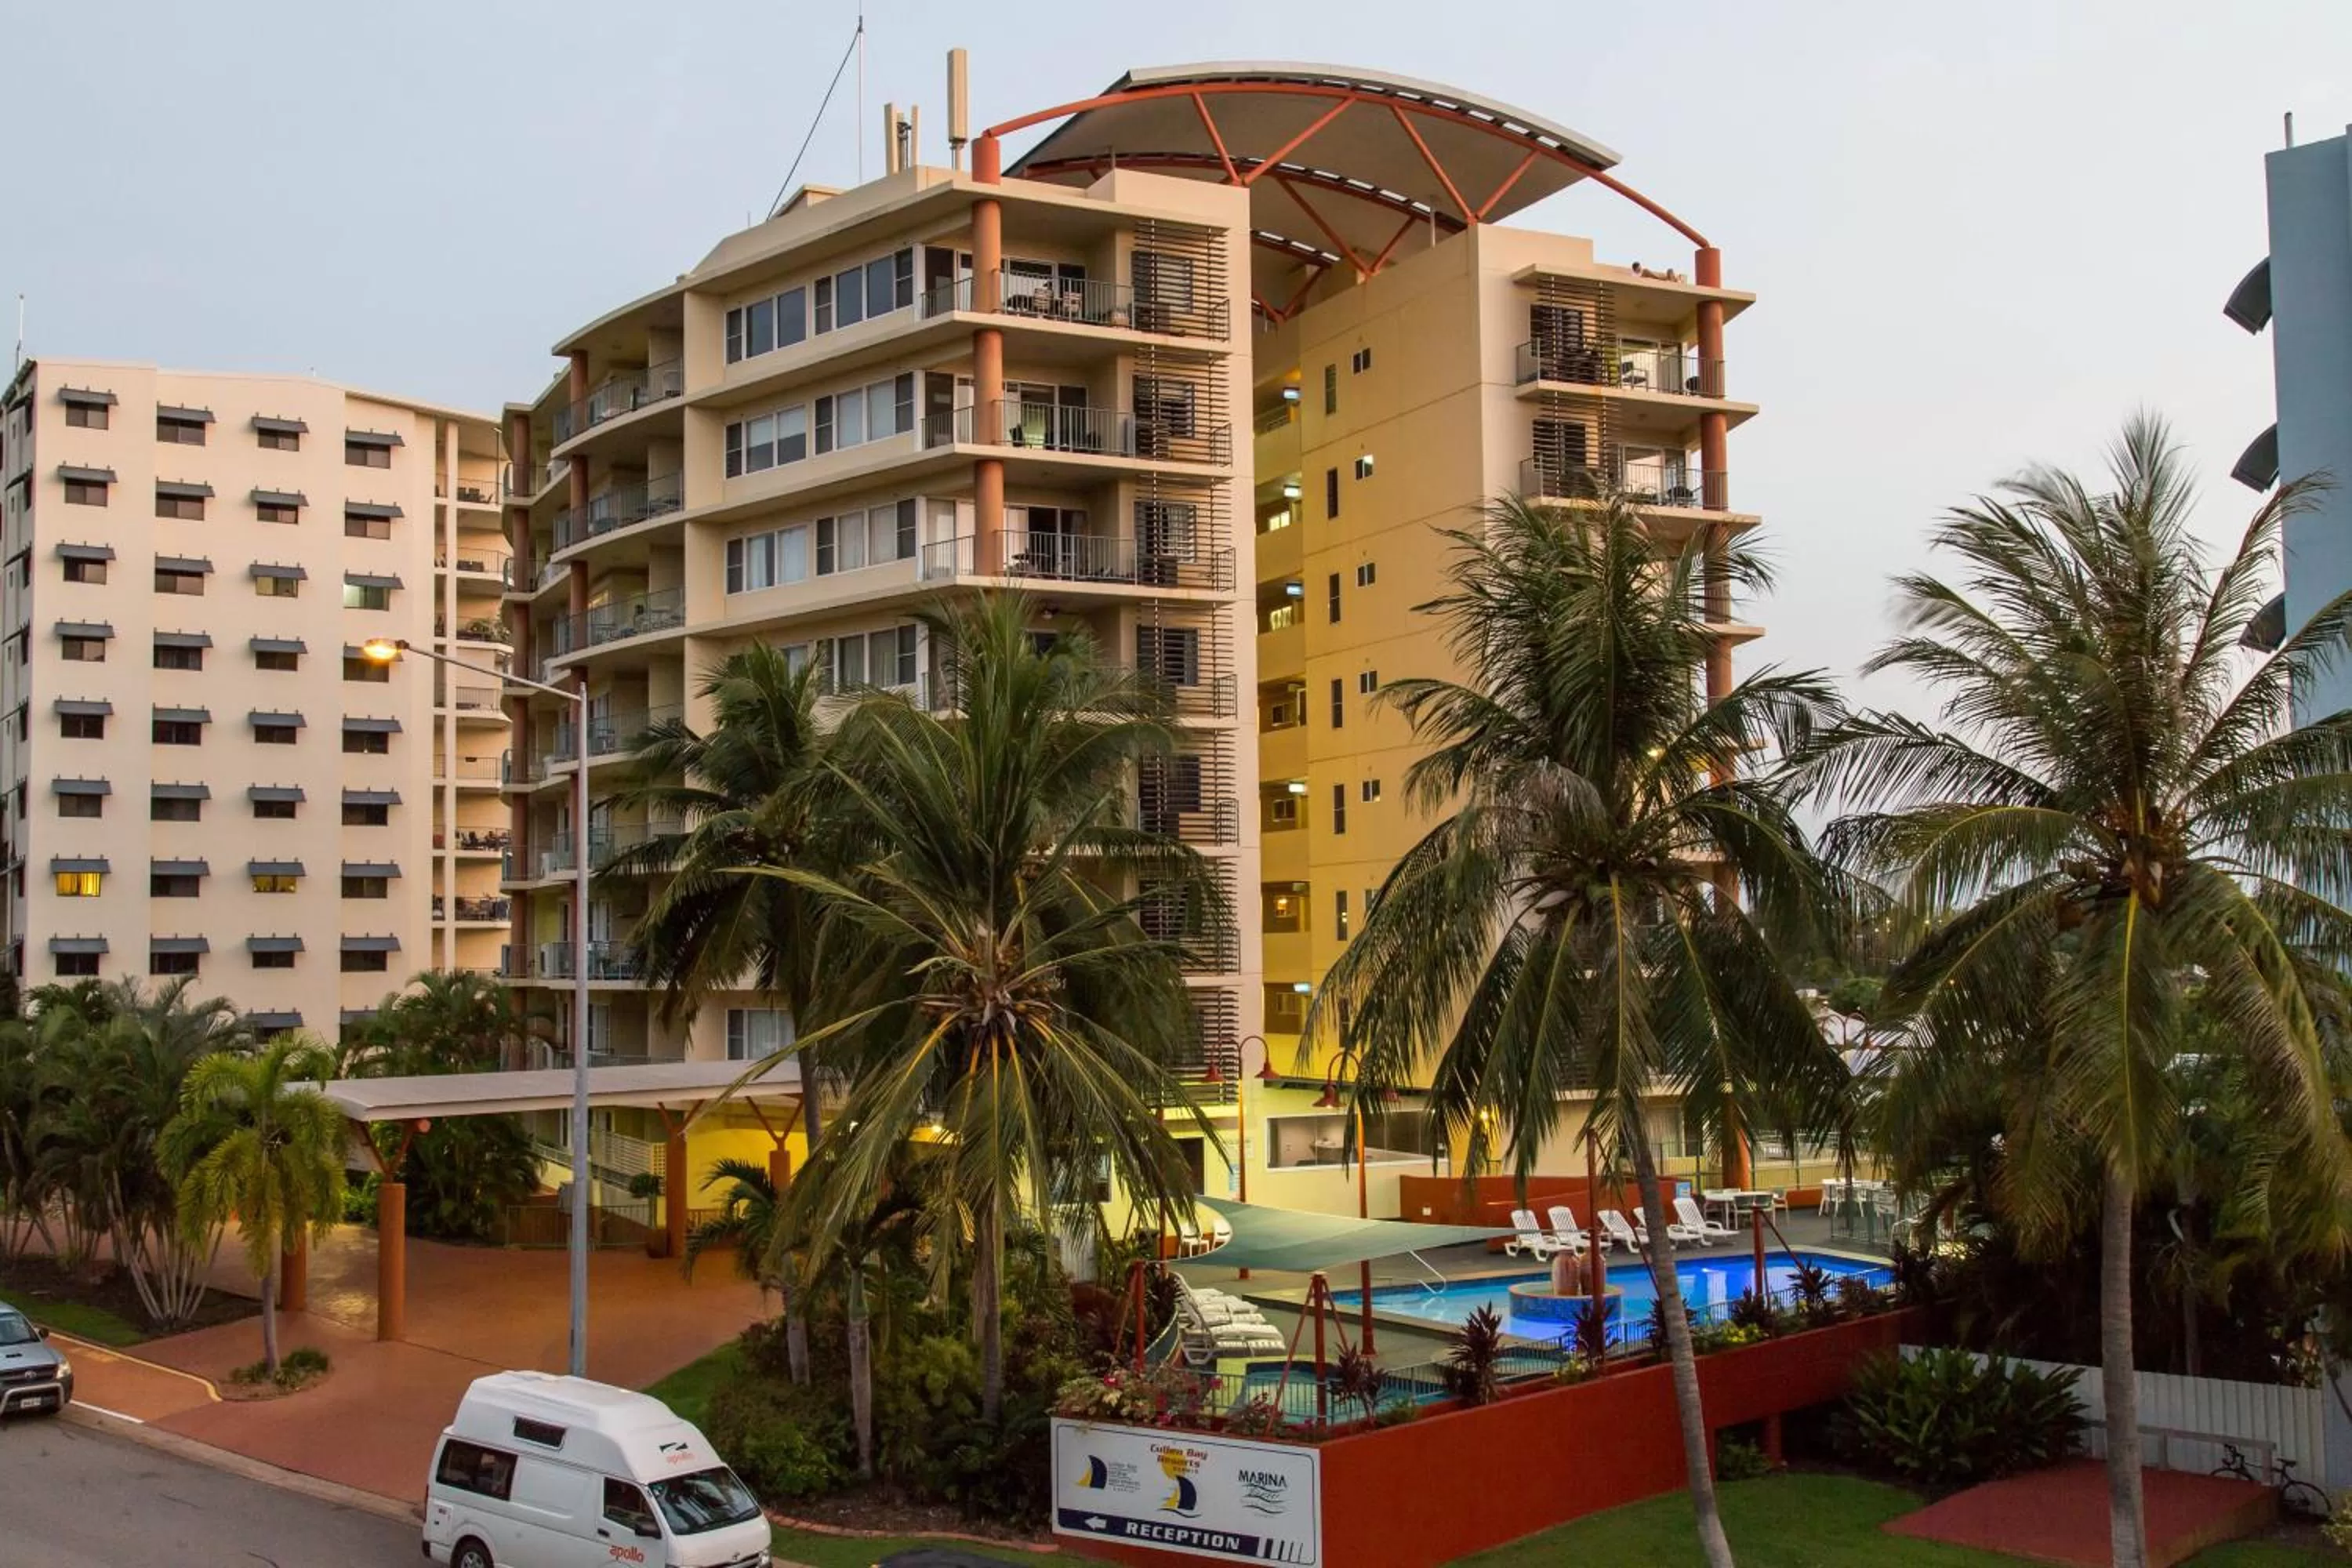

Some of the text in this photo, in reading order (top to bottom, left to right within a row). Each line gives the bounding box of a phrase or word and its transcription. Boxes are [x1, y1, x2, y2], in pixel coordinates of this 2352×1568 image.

[1186, 1448, 1208, 1461] Bay
[1239, 1469, 1287, 1488] MARINA
[1125, 1521, 1240, 1550] RECEPTION
[609, 1544, 644, 1563] apollo
